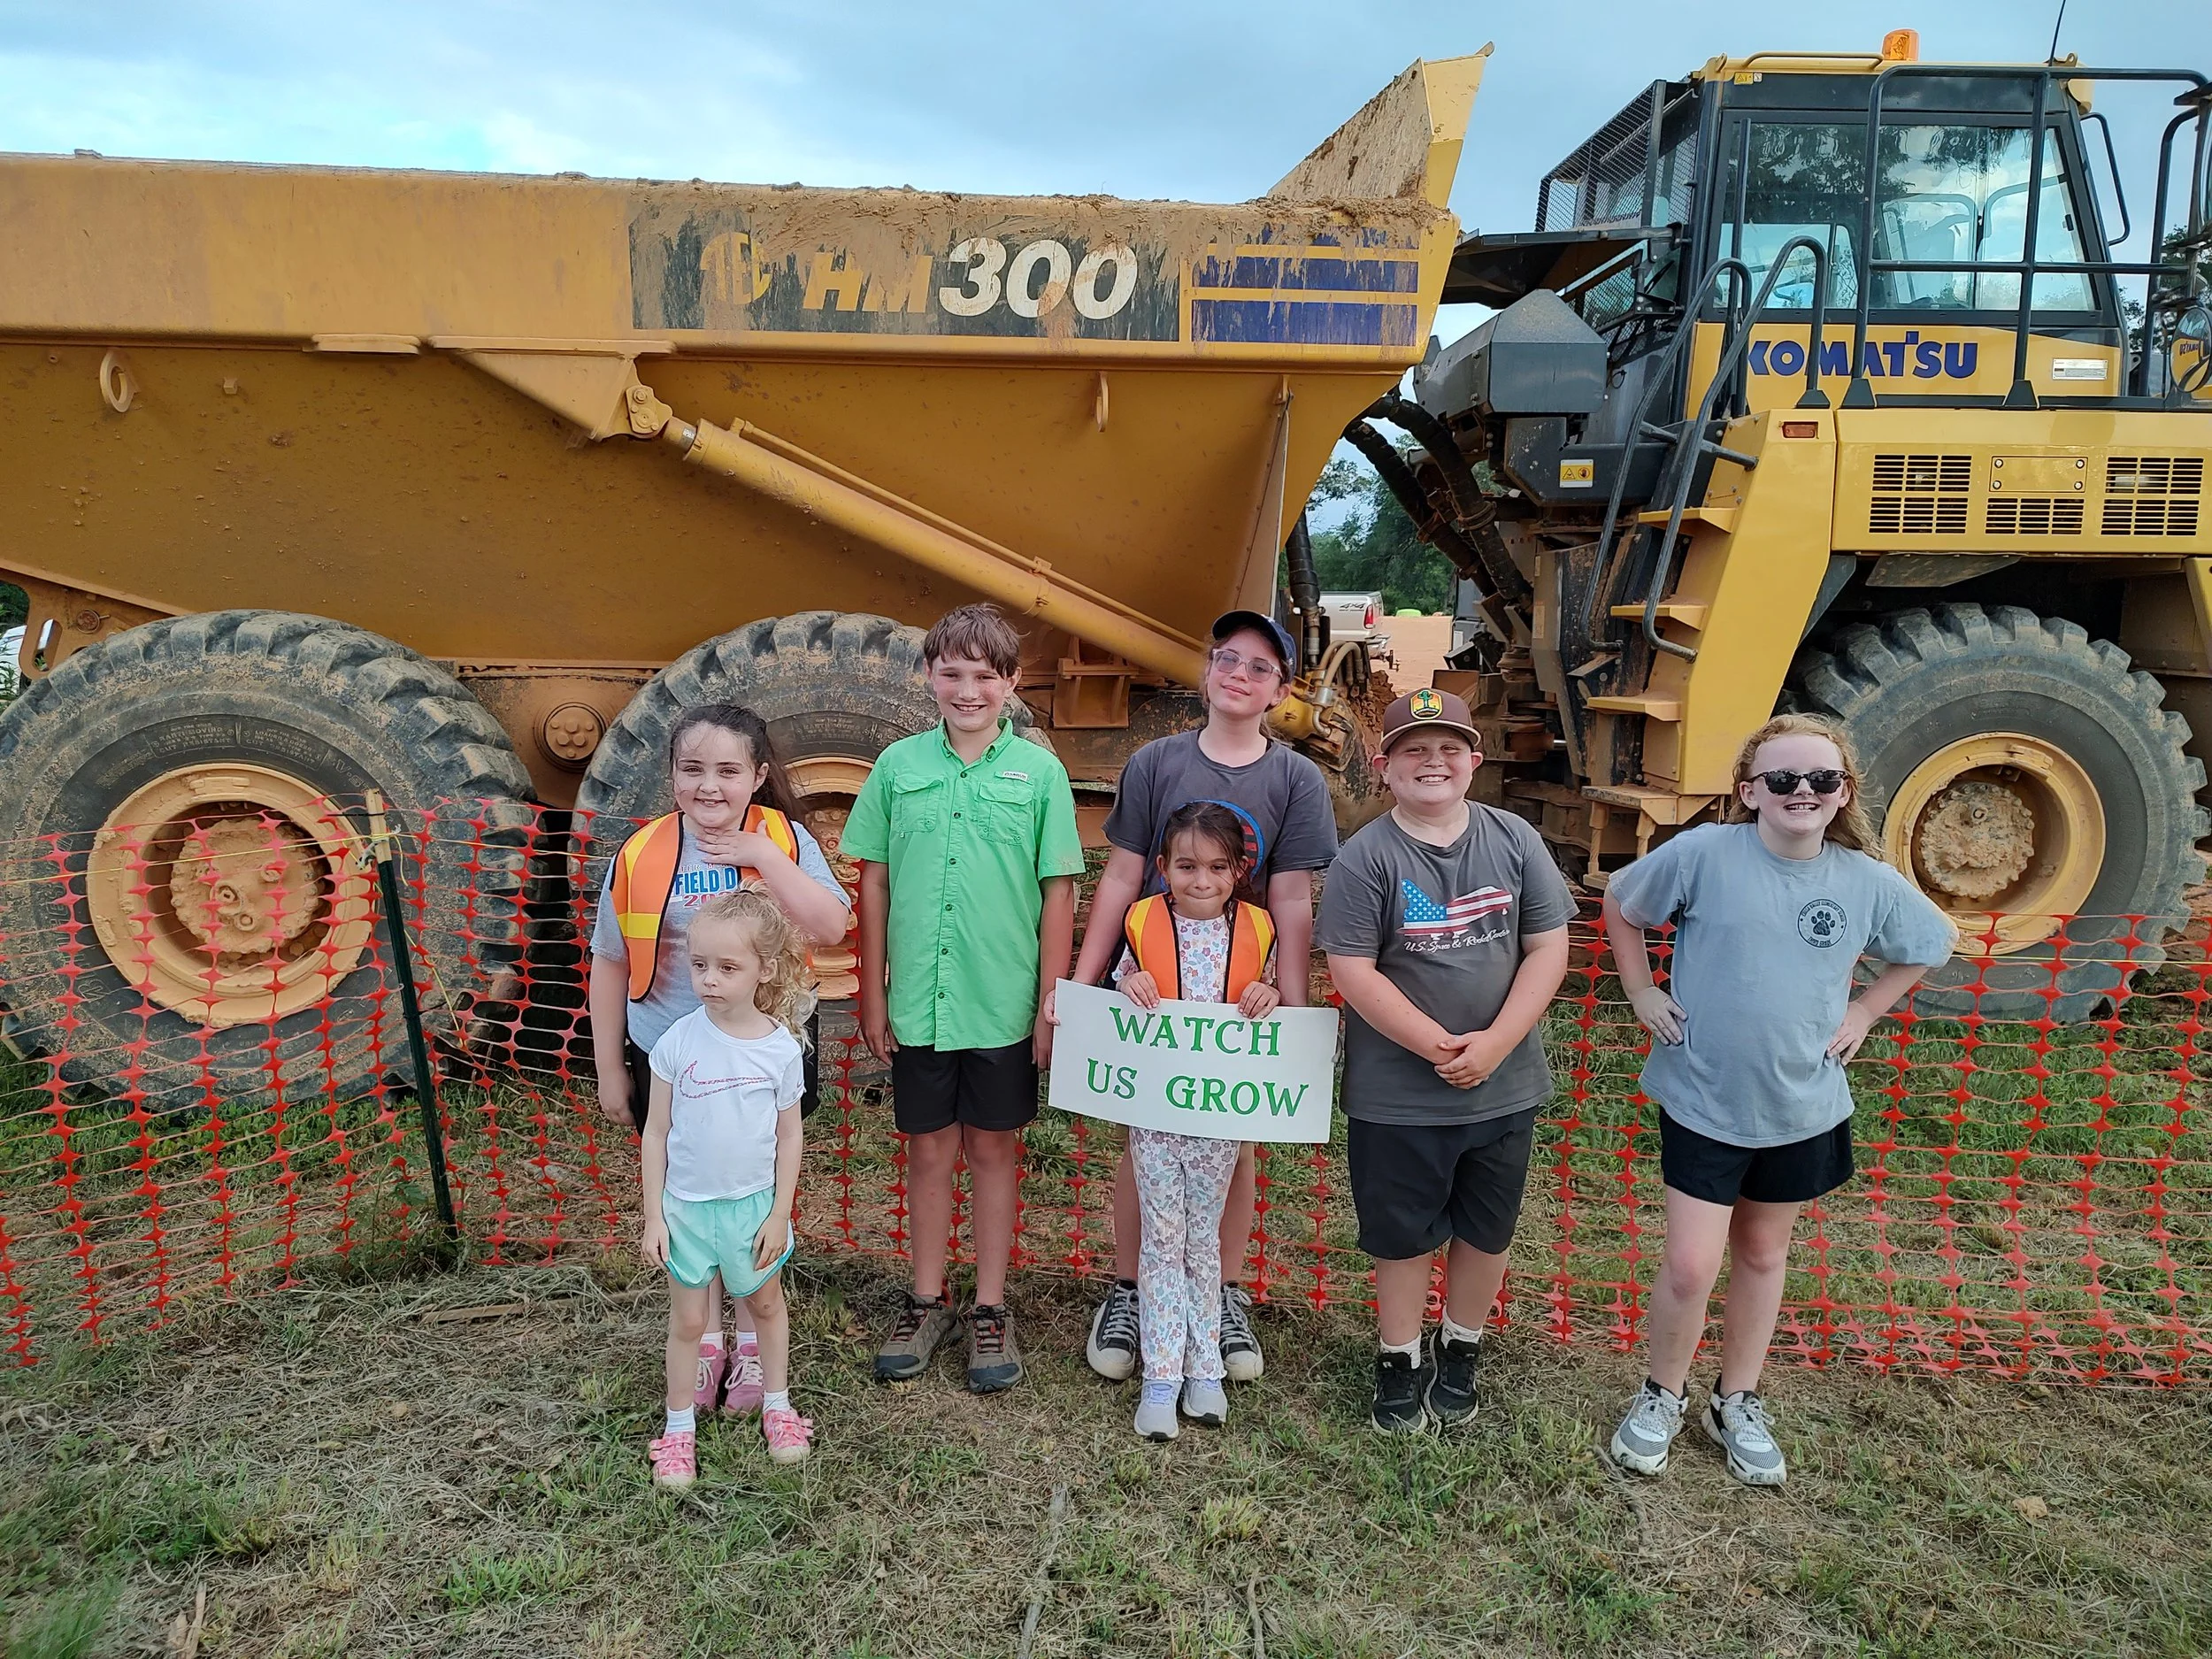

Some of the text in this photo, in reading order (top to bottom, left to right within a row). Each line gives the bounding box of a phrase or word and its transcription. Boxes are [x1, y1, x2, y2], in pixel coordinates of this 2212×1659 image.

[1748, 331, 1978, 379] KOMATSU
[675, 870, 720, 895] FIELD
[1451, 940, 1462, 949] &
[1108, 1006, 1282, 1056] WATCH
[1087, 1057, 1310, 1118] US GROW
